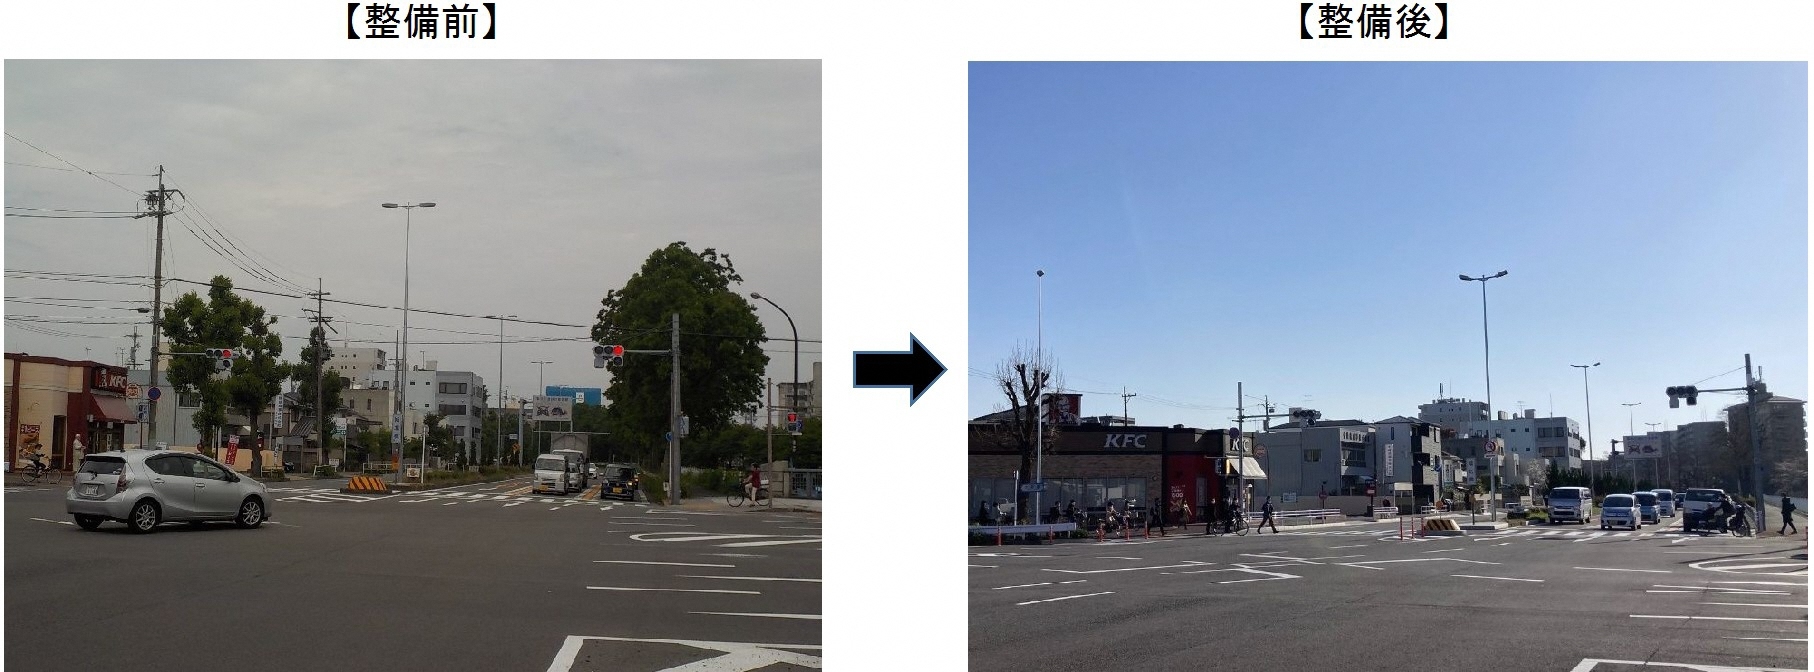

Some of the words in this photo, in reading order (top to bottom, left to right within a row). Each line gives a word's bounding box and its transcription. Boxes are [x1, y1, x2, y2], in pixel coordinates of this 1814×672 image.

[108, 374, 127, 389] KFC
[1103, 433, 1147, 449] KFC
[1231, 438, 1250, 452] KC
